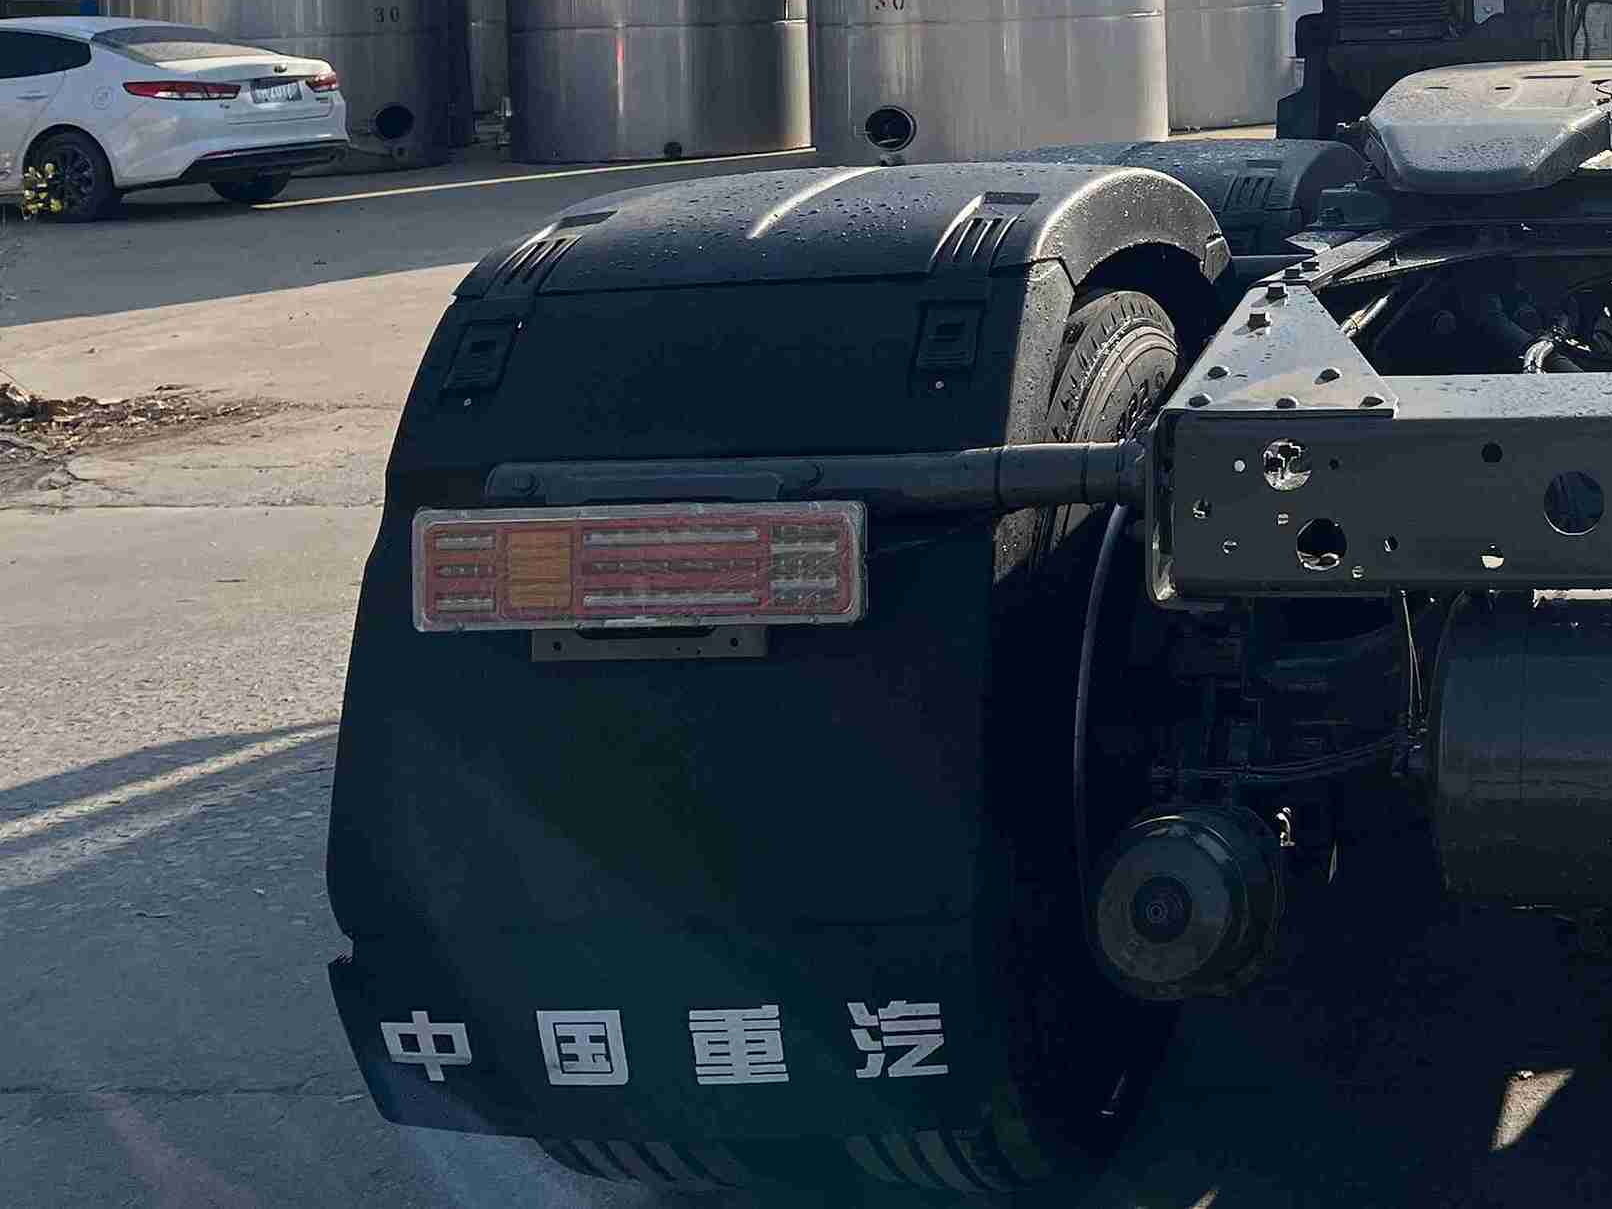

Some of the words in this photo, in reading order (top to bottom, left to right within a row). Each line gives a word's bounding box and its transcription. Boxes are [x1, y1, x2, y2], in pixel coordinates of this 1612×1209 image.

[374, 6, 400, 23] 30
[380, 1000, 948, 1086] 中国重汽
